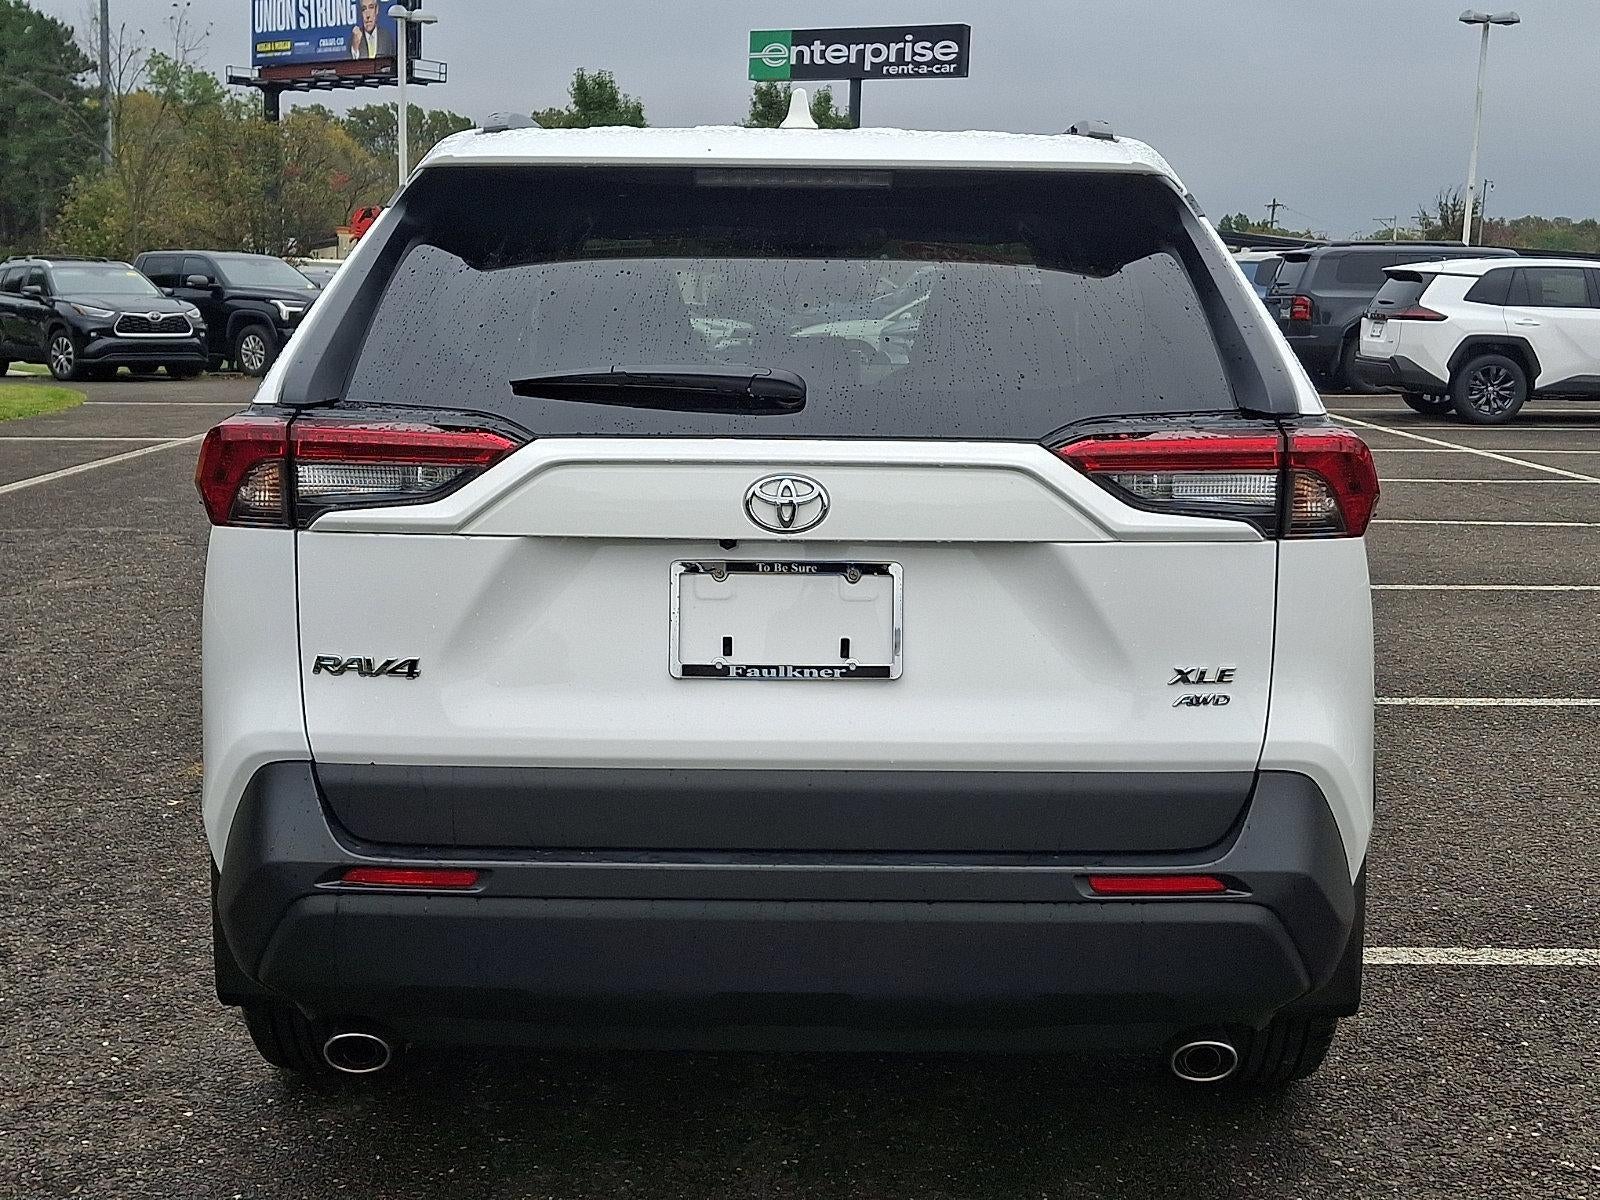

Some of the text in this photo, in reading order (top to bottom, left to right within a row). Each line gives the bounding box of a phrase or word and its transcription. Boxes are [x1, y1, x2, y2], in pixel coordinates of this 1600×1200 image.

[254, 0, 357, 33] UNION STRONG
[750, 34, 959, 71] enterprise
[882, 62, 957, 75] rent-a-car
[756, 562, 818, 573] To Be Sure
[312, 653, 422, 680] RAV4
[728, 665, 847, 678] Faulkner
[1166, 666, 1237, 686] XLE
[1171, 693, 1231, 707] AWD
